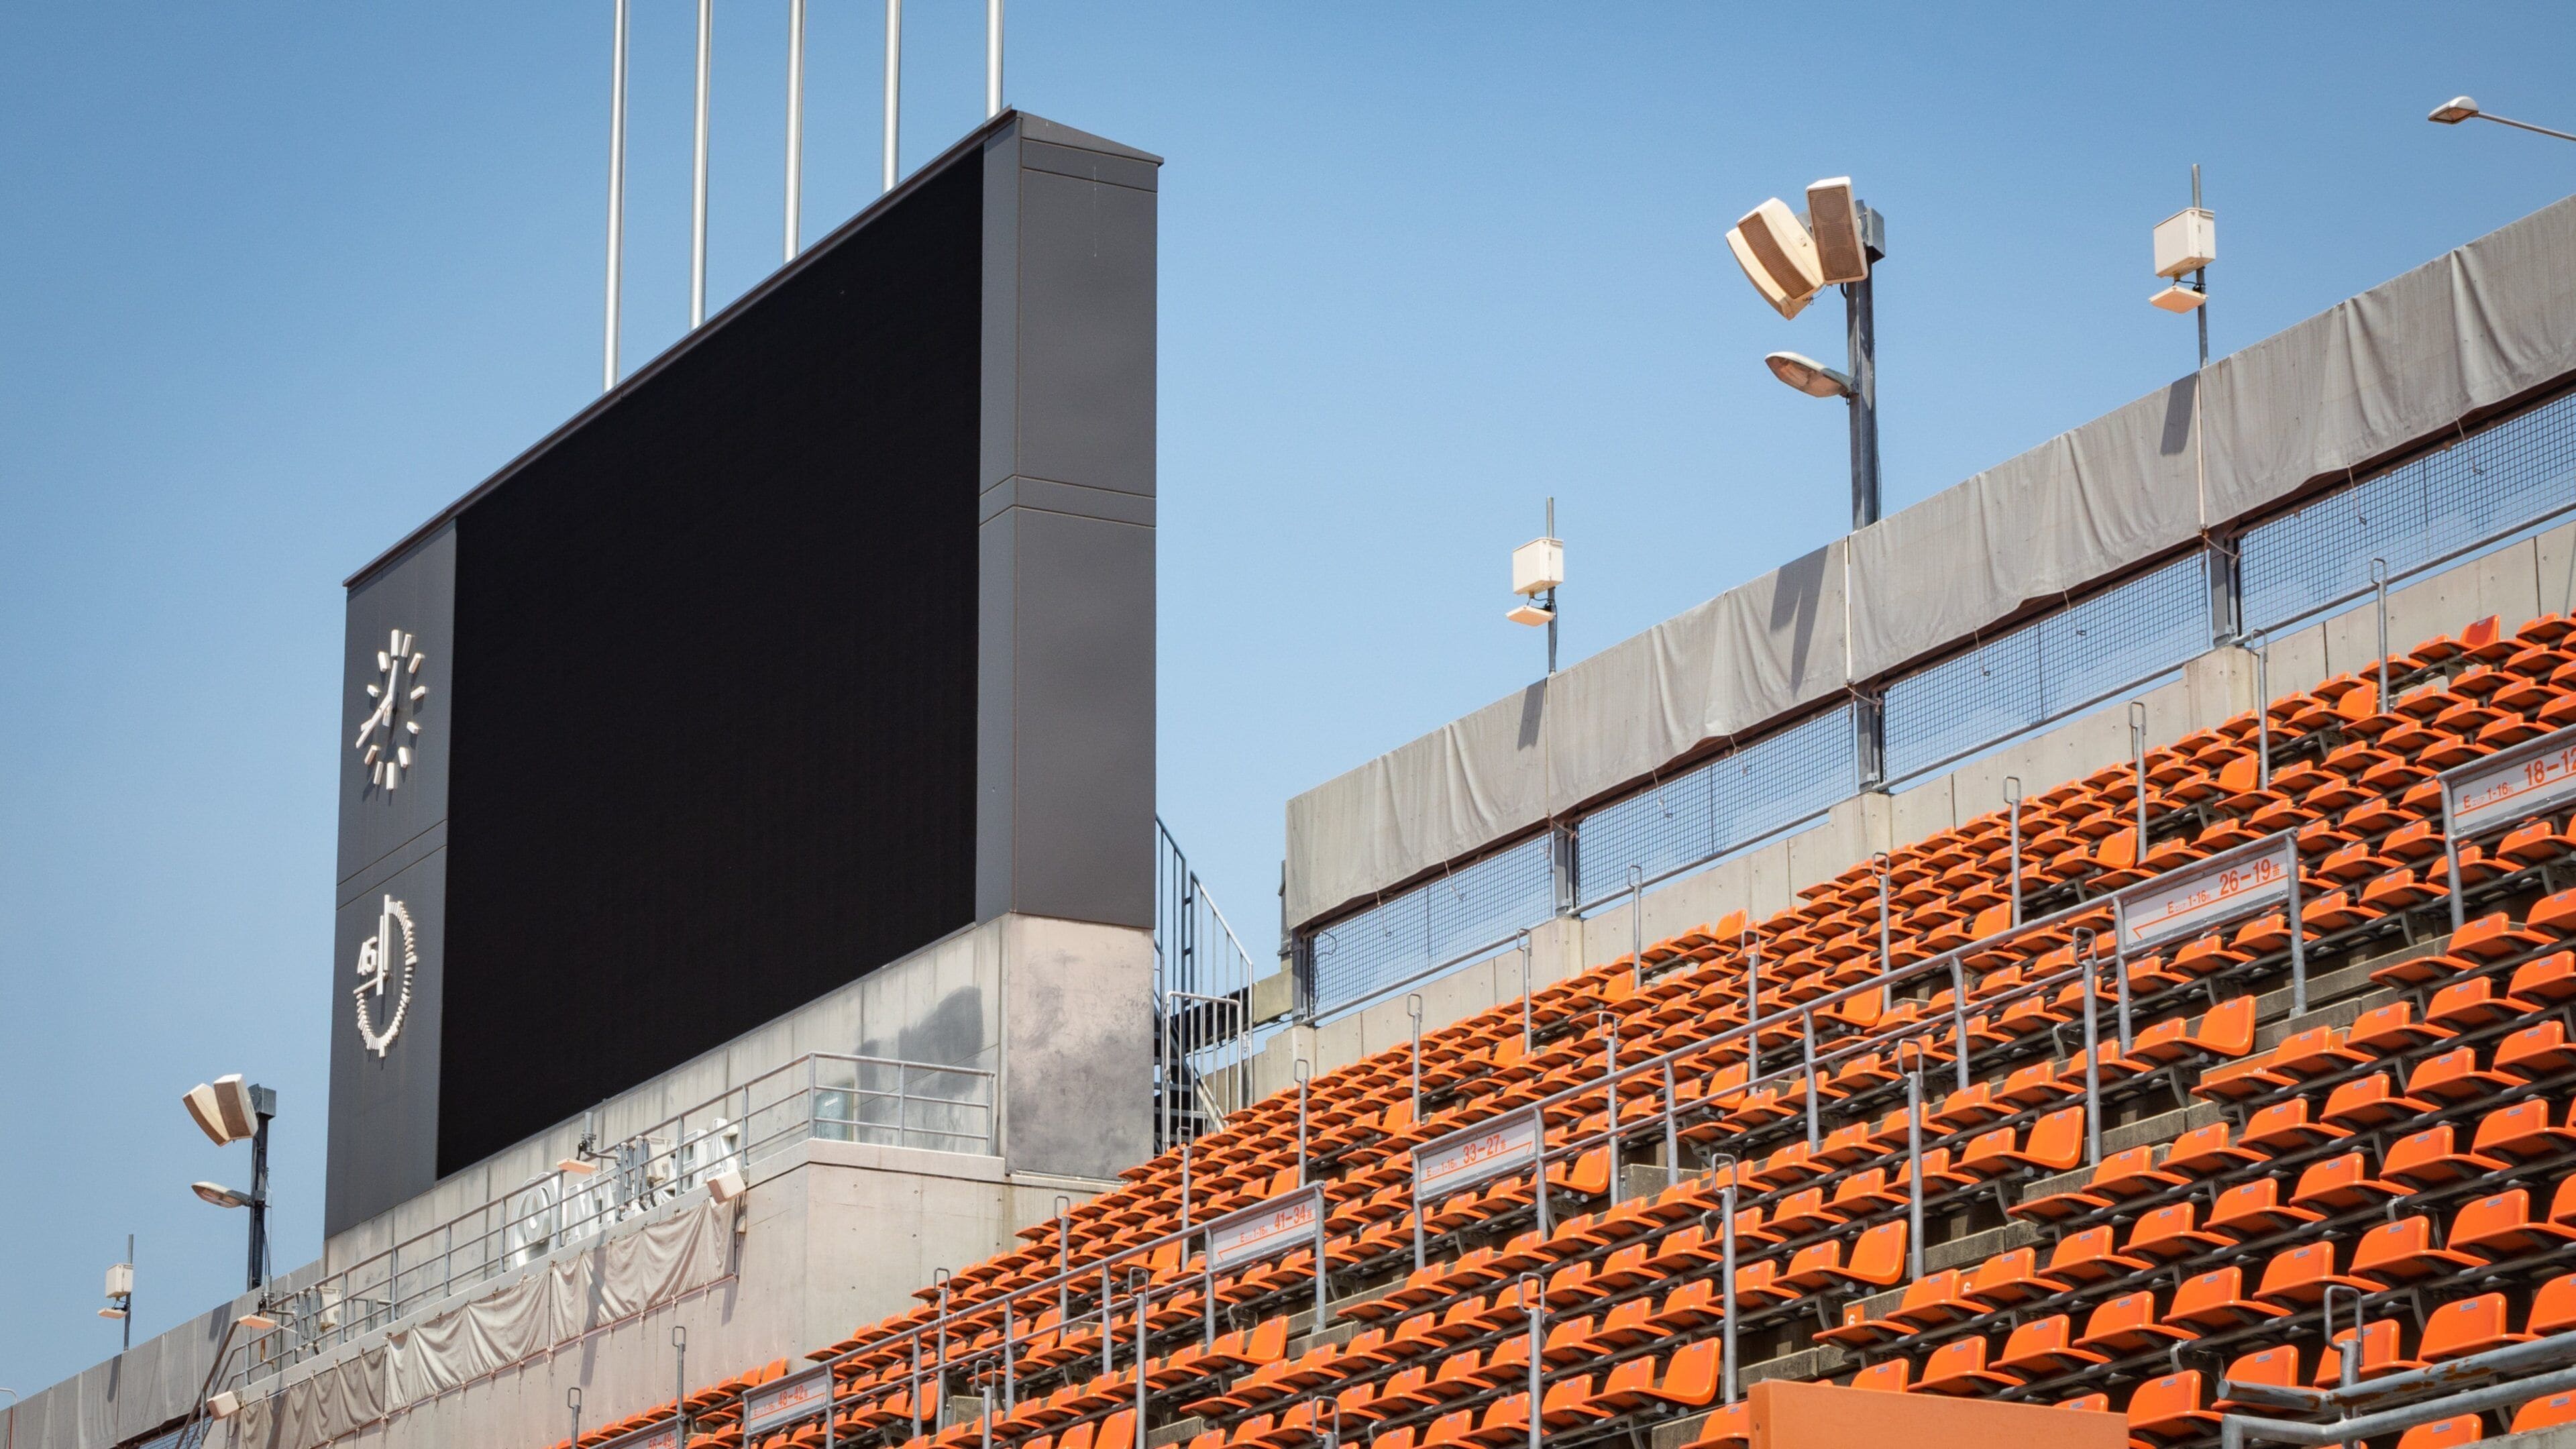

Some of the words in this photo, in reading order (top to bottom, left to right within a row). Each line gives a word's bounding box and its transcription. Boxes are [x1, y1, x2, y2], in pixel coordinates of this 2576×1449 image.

[2463, 794, 2471, 809] E
[2167, 901, 2174, 914] E
[1426, 1166, 1432, 1177] E
[1441, 1158, 1458, 1172] 1-16
